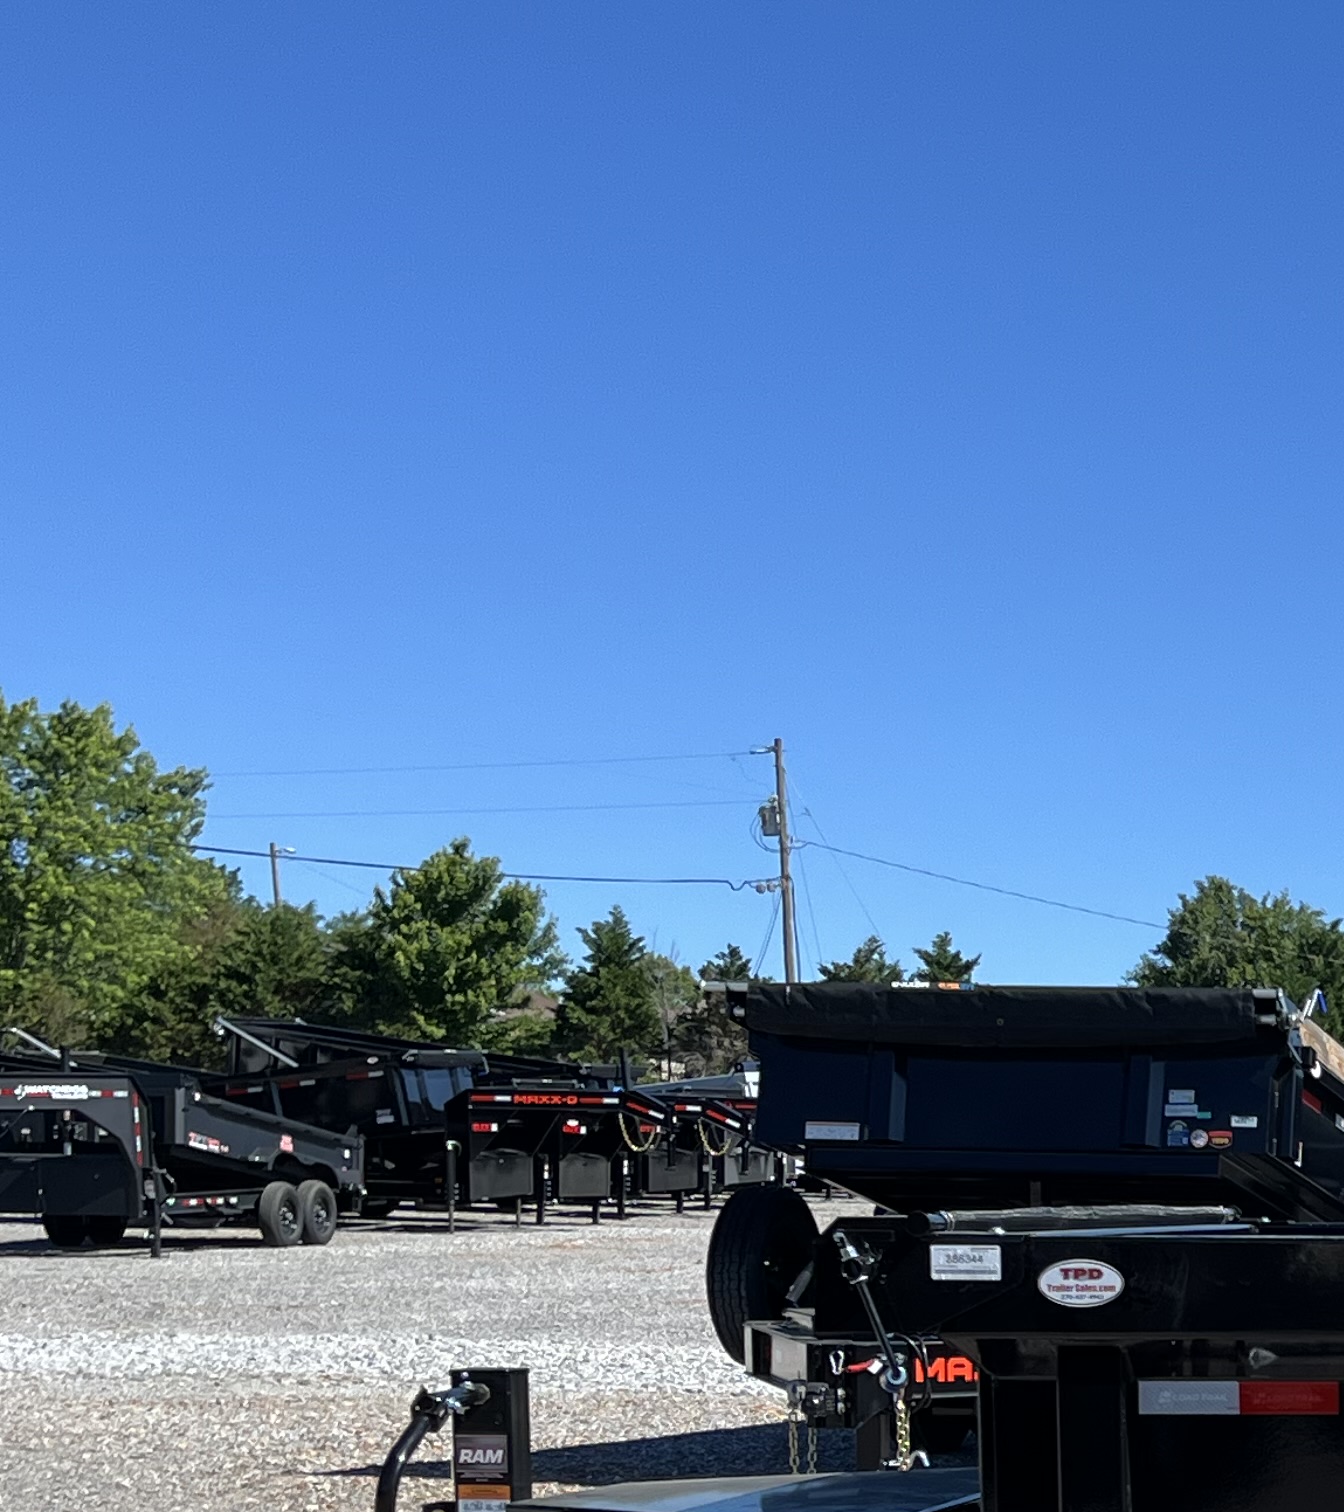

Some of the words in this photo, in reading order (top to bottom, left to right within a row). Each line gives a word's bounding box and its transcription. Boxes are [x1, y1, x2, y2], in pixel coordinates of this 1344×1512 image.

[1059, 1267, 1104, 1281] TPD
[915, 1356, 979, 1383] MA
[458, 1449, 505, 1464] RAM
